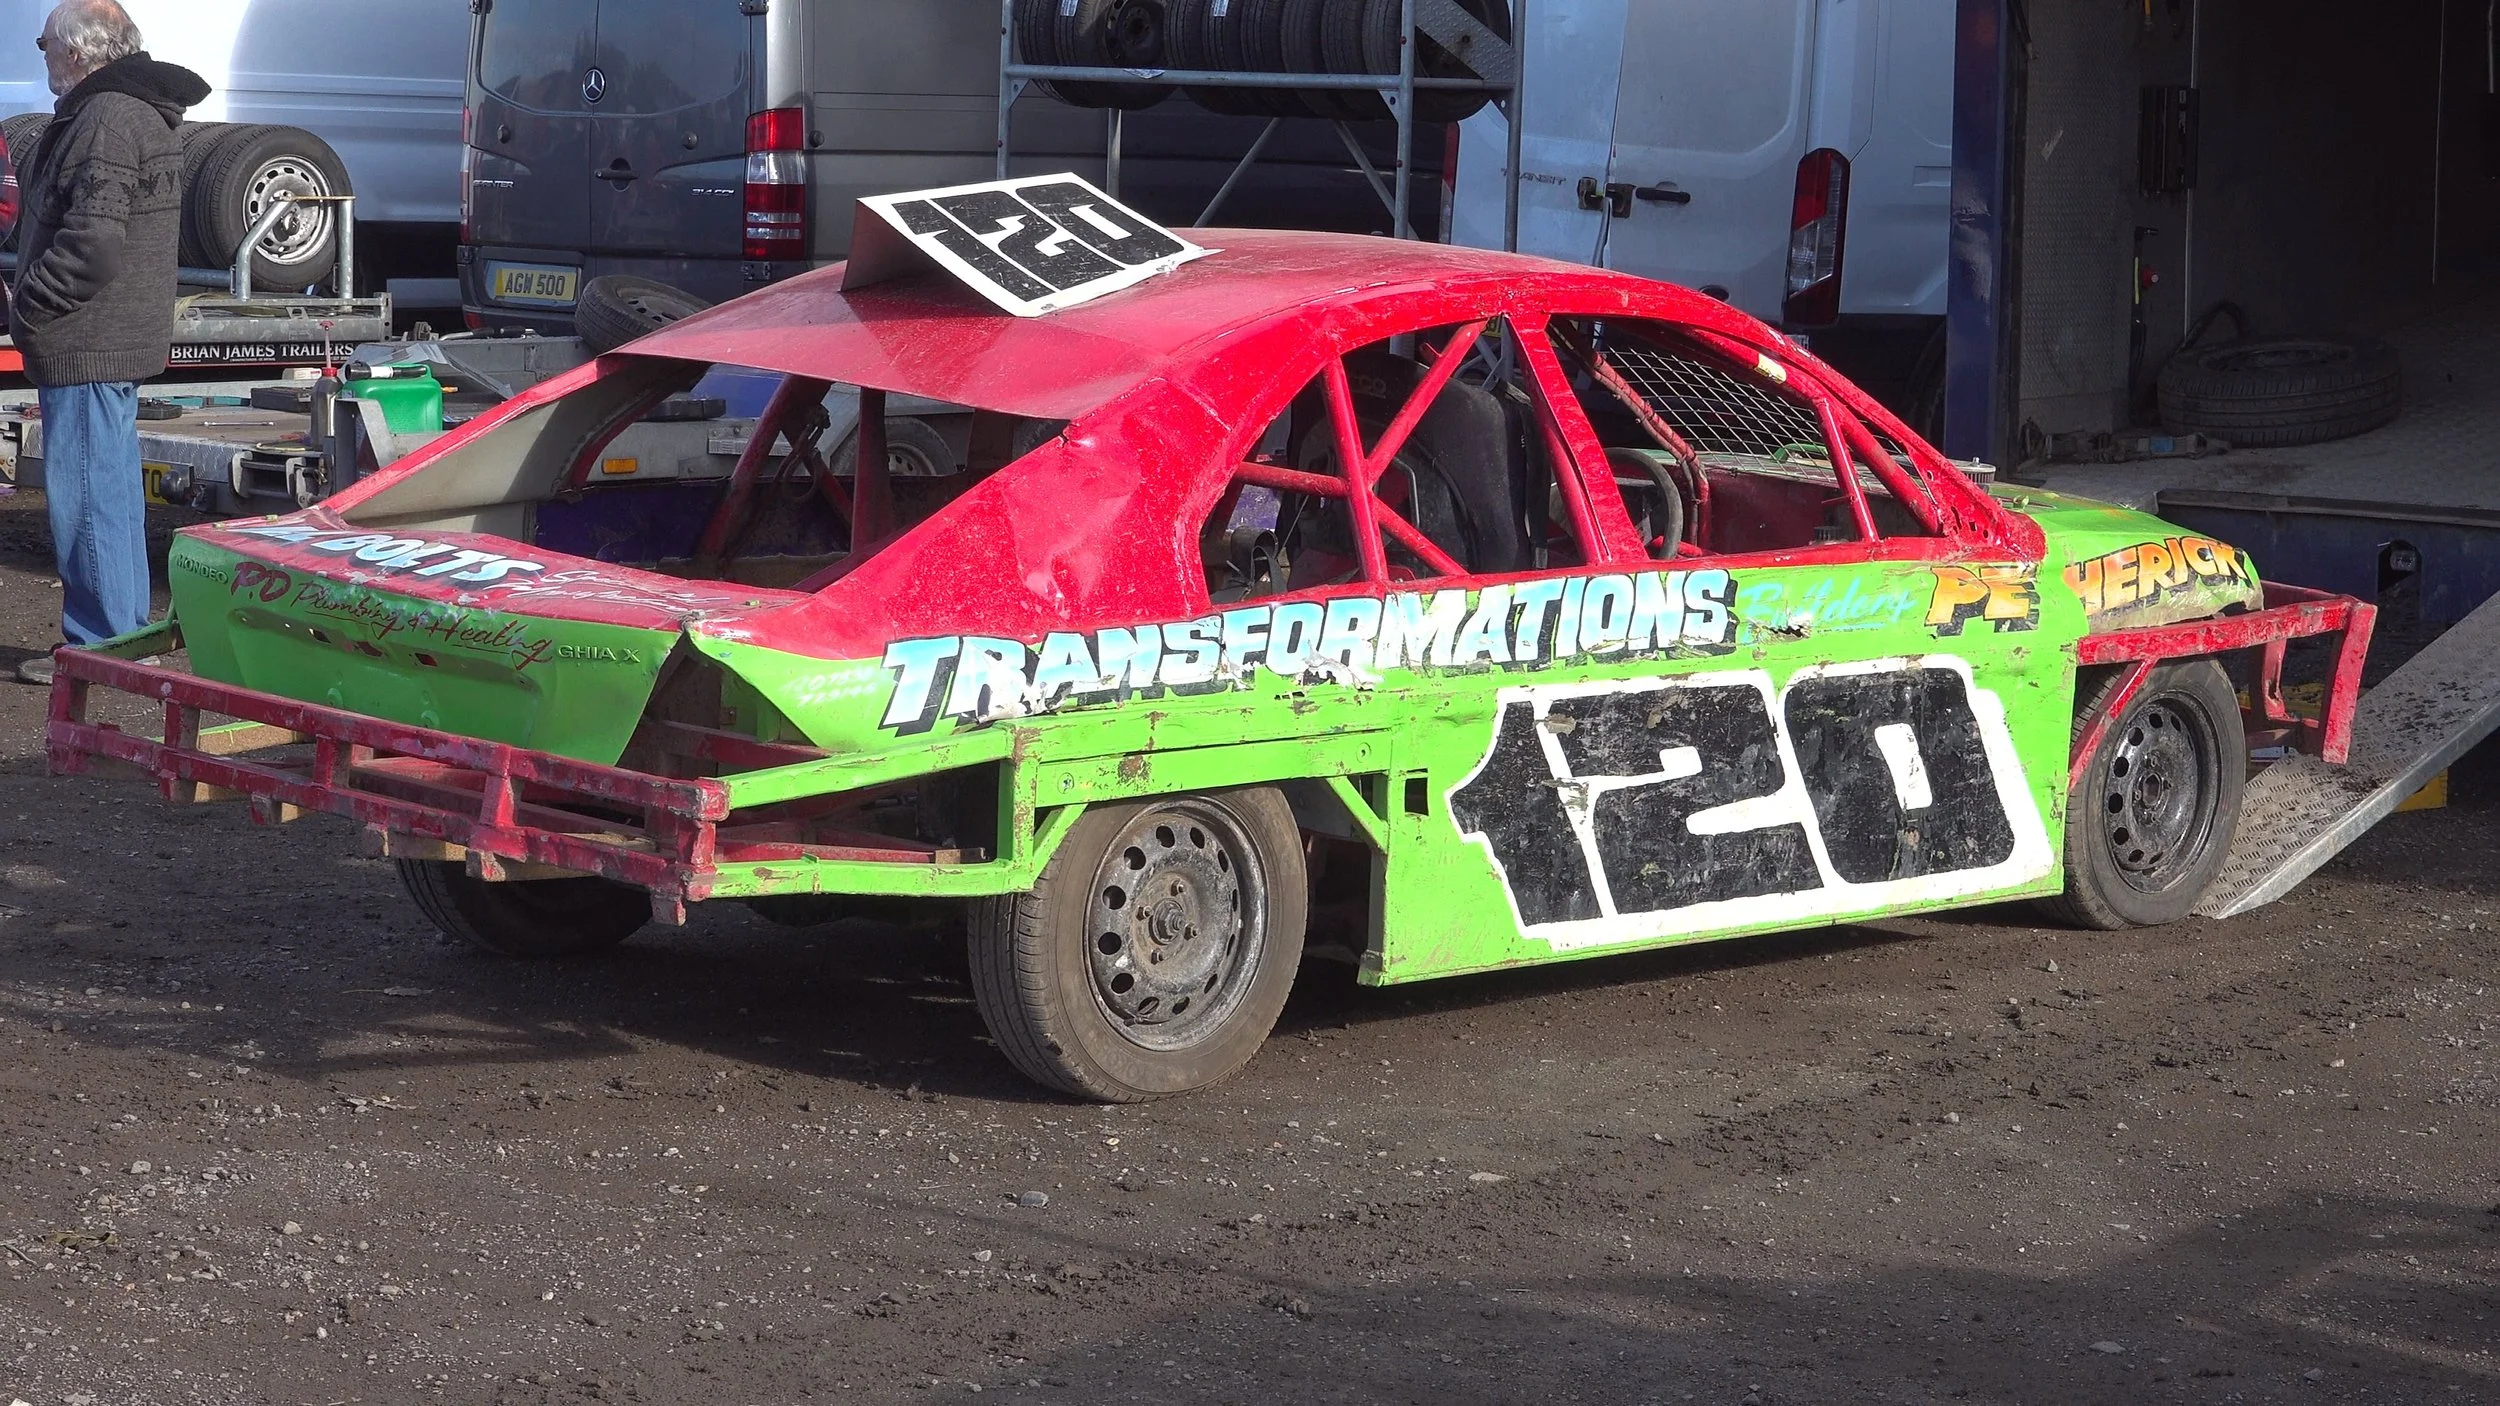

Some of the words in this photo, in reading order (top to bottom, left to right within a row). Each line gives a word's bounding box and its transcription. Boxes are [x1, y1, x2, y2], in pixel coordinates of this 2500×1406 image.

[891, 182, 1185, 302] 120
[536, 274, 566, 297] 500
[171, 345, 220, 359] BRIAN
[222, 344, 276, 360] JAMES
[176, 553, 229, 585] MONDEO
[310, 534, 545, 583] BOLTS
[290, 580, 405, 640] Plumbing
[424, 613, 553, 671] Heating
[557, 644, 617, 662] GHIA
[622, 646, 641, 663] X
[882, 568, 1738, 736] TRANSFORMATIONS
[1451, 667, 2016, 926] 120
